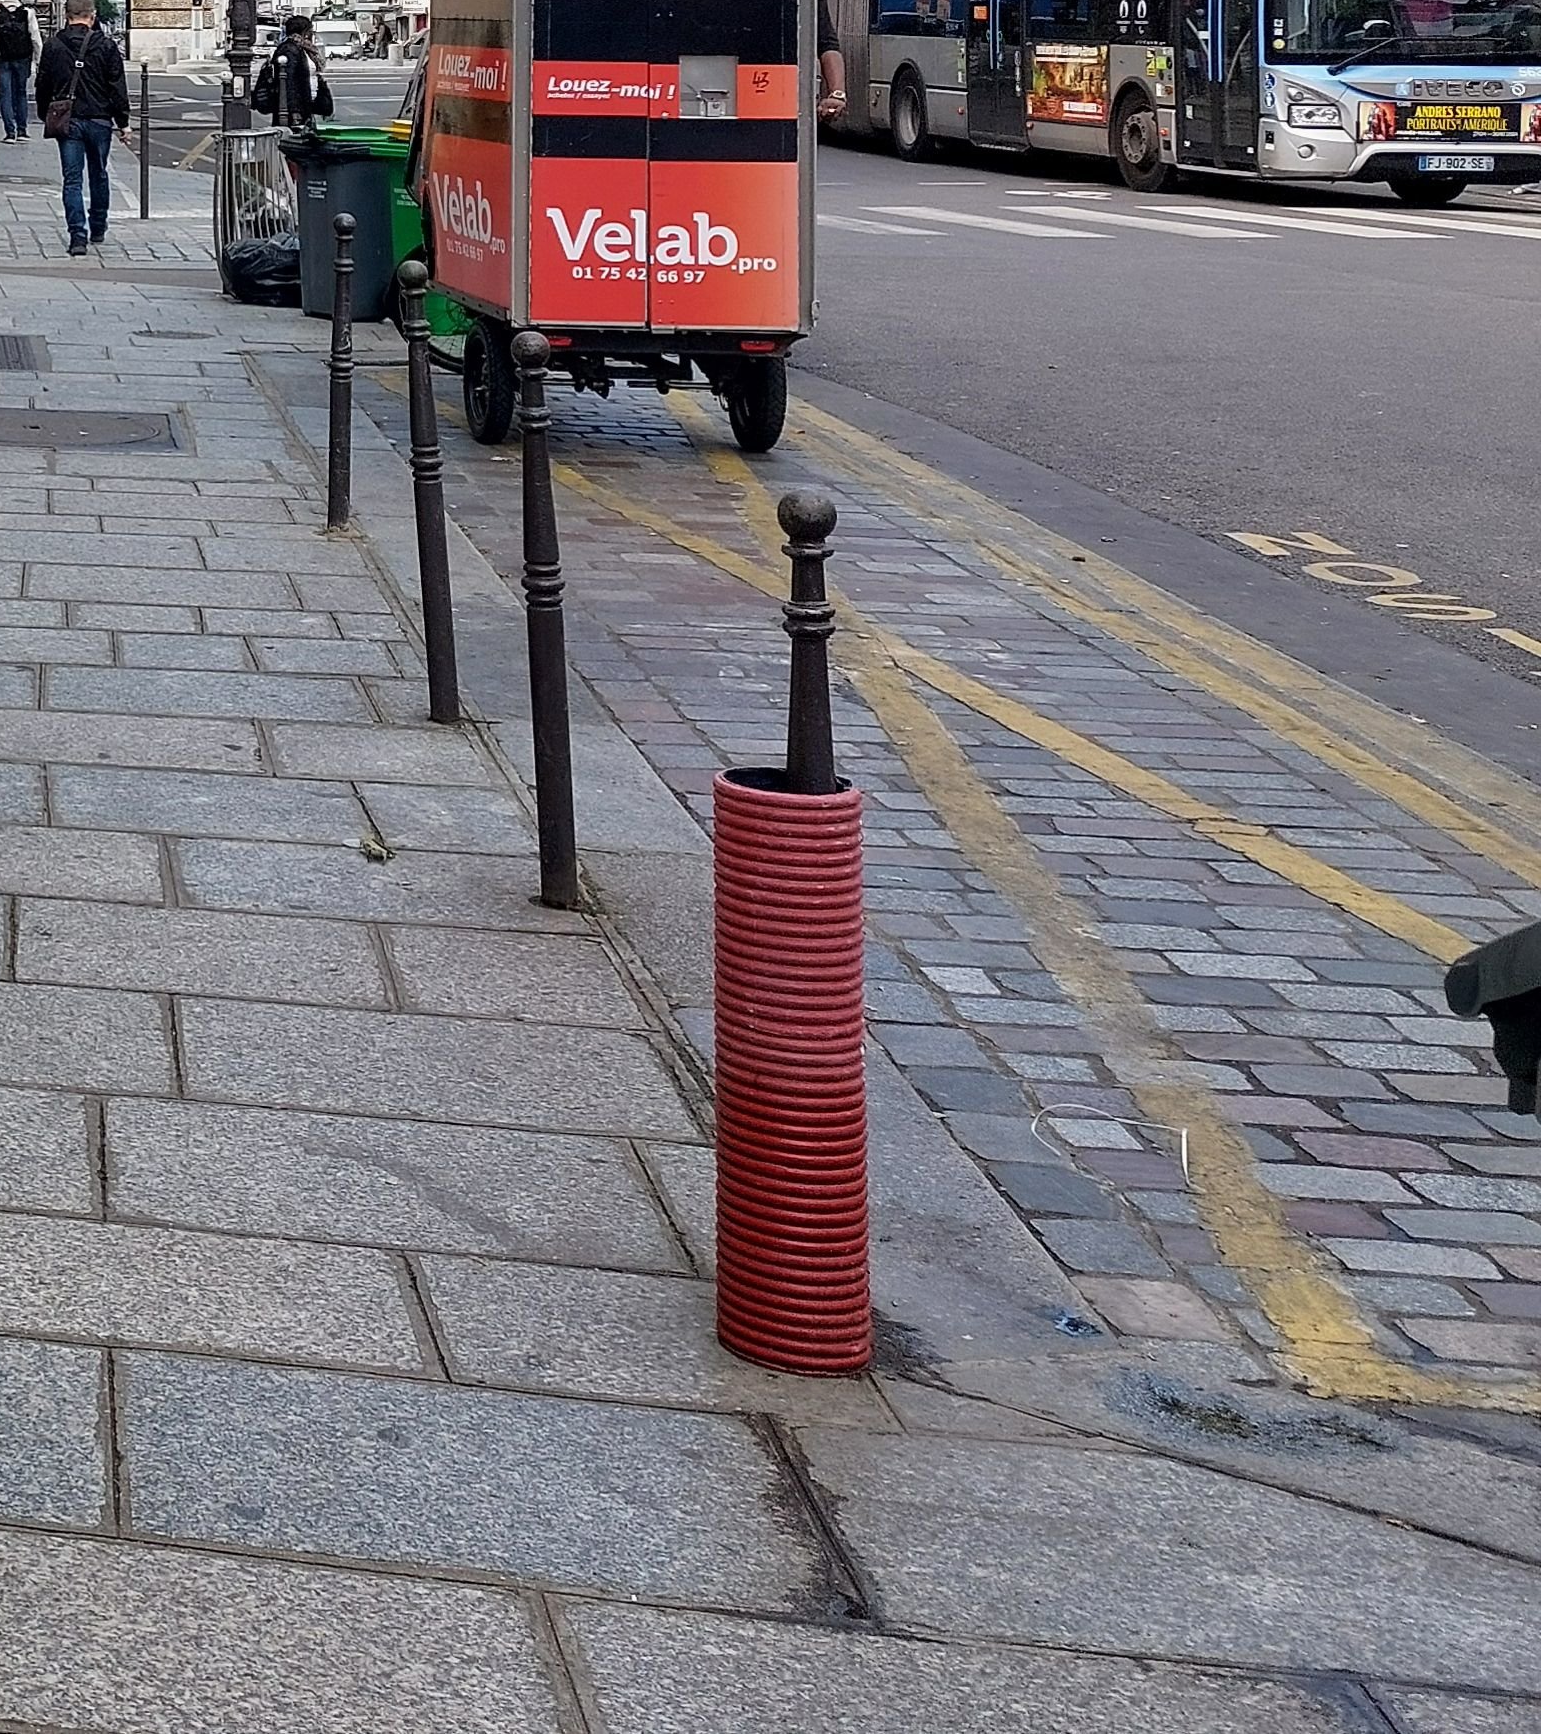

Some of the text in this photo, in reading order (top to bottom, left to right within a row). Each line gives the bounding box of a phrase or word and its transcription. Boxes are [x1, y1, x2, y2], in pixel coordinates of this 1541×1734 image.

[437, 48, 500, 91] Louez-moi
[547, 76, 662, 100] Louez-moi
[752, 70, 769, 89] 43
[1413, 79, 1504, 98] IVECO
[1455, 105, 1502, 118] SERRANO
[1427, 157, 1485, 170] FJ-902-SE
[572, 266, 706, 284] 01 75 42 66 97
